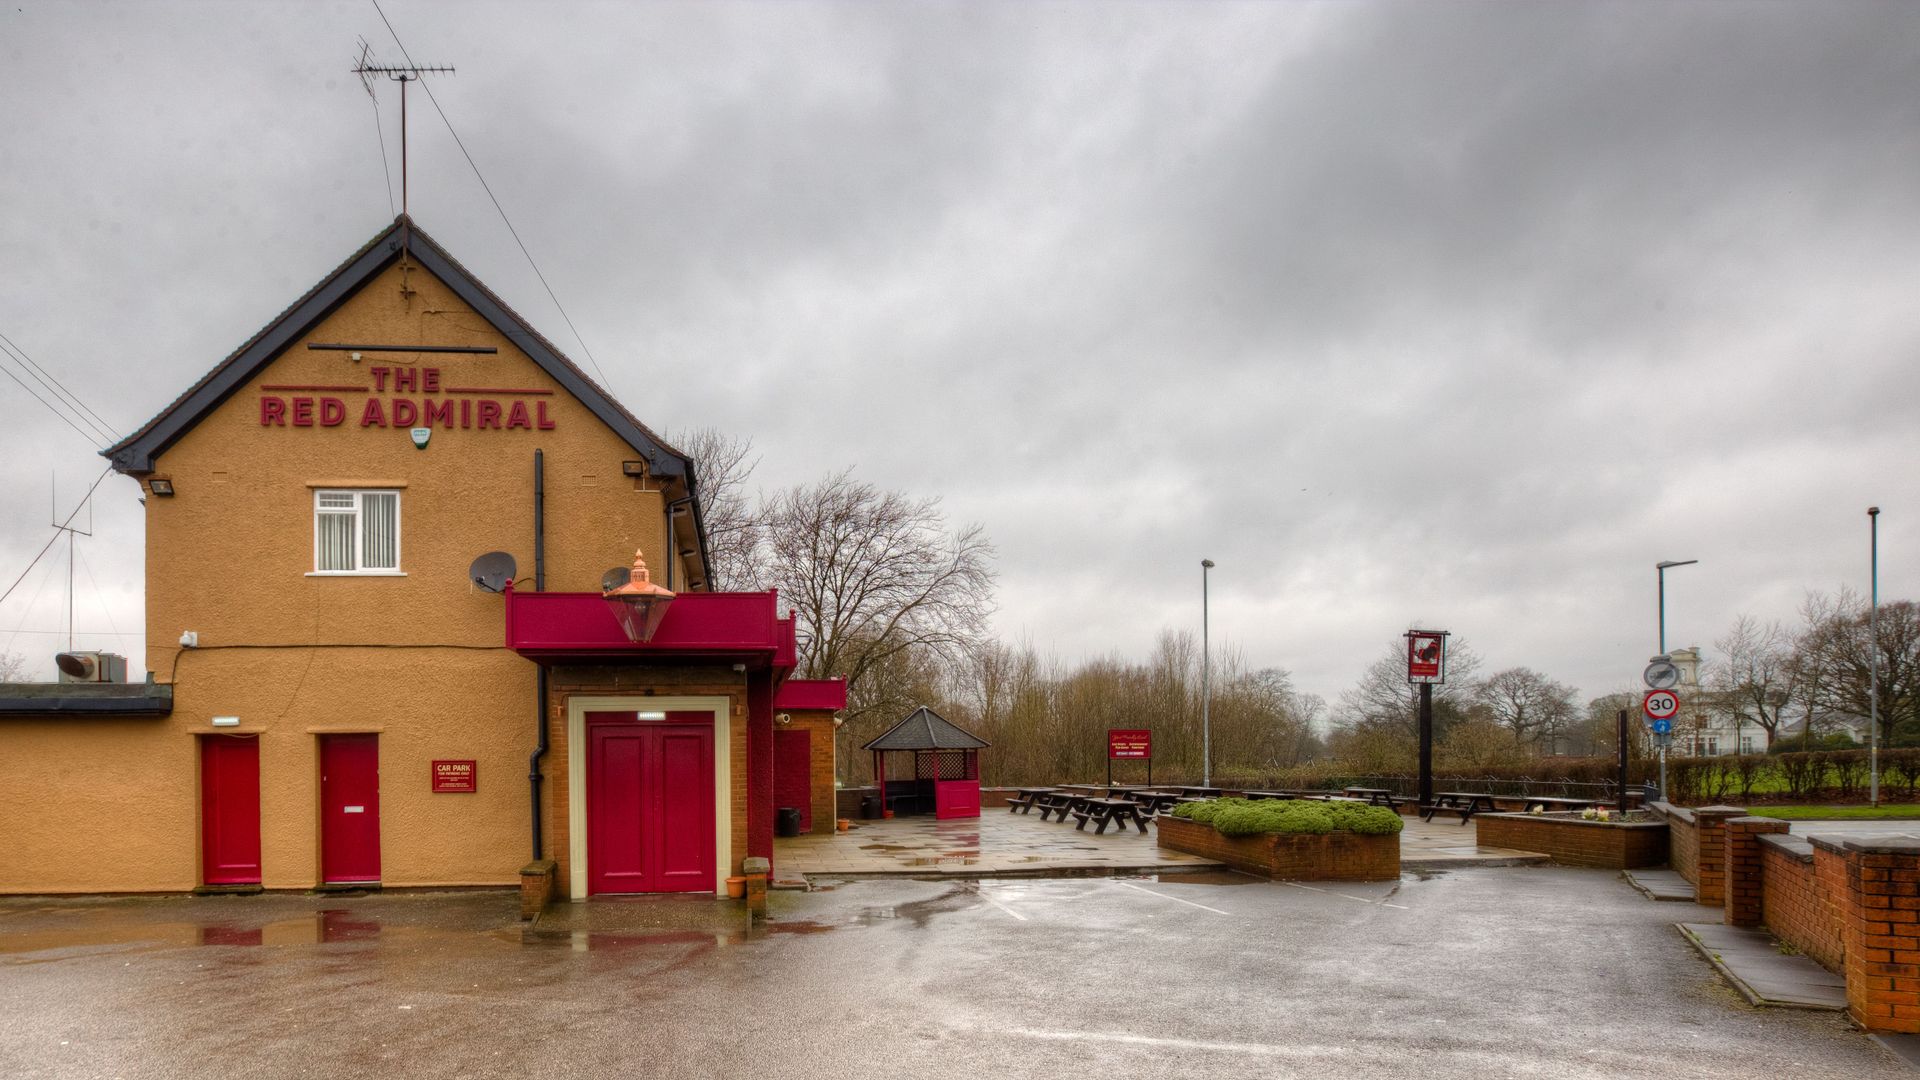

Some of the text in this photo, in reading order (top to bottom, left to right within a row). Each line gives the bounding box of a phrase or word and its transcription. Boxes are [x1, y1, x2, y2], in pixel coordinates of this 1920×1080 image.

[371, 367, 440, 392] THE
[261, 397, 555, 429] RED ADMIRAL
[1650, 698, 1673, 711] 30
